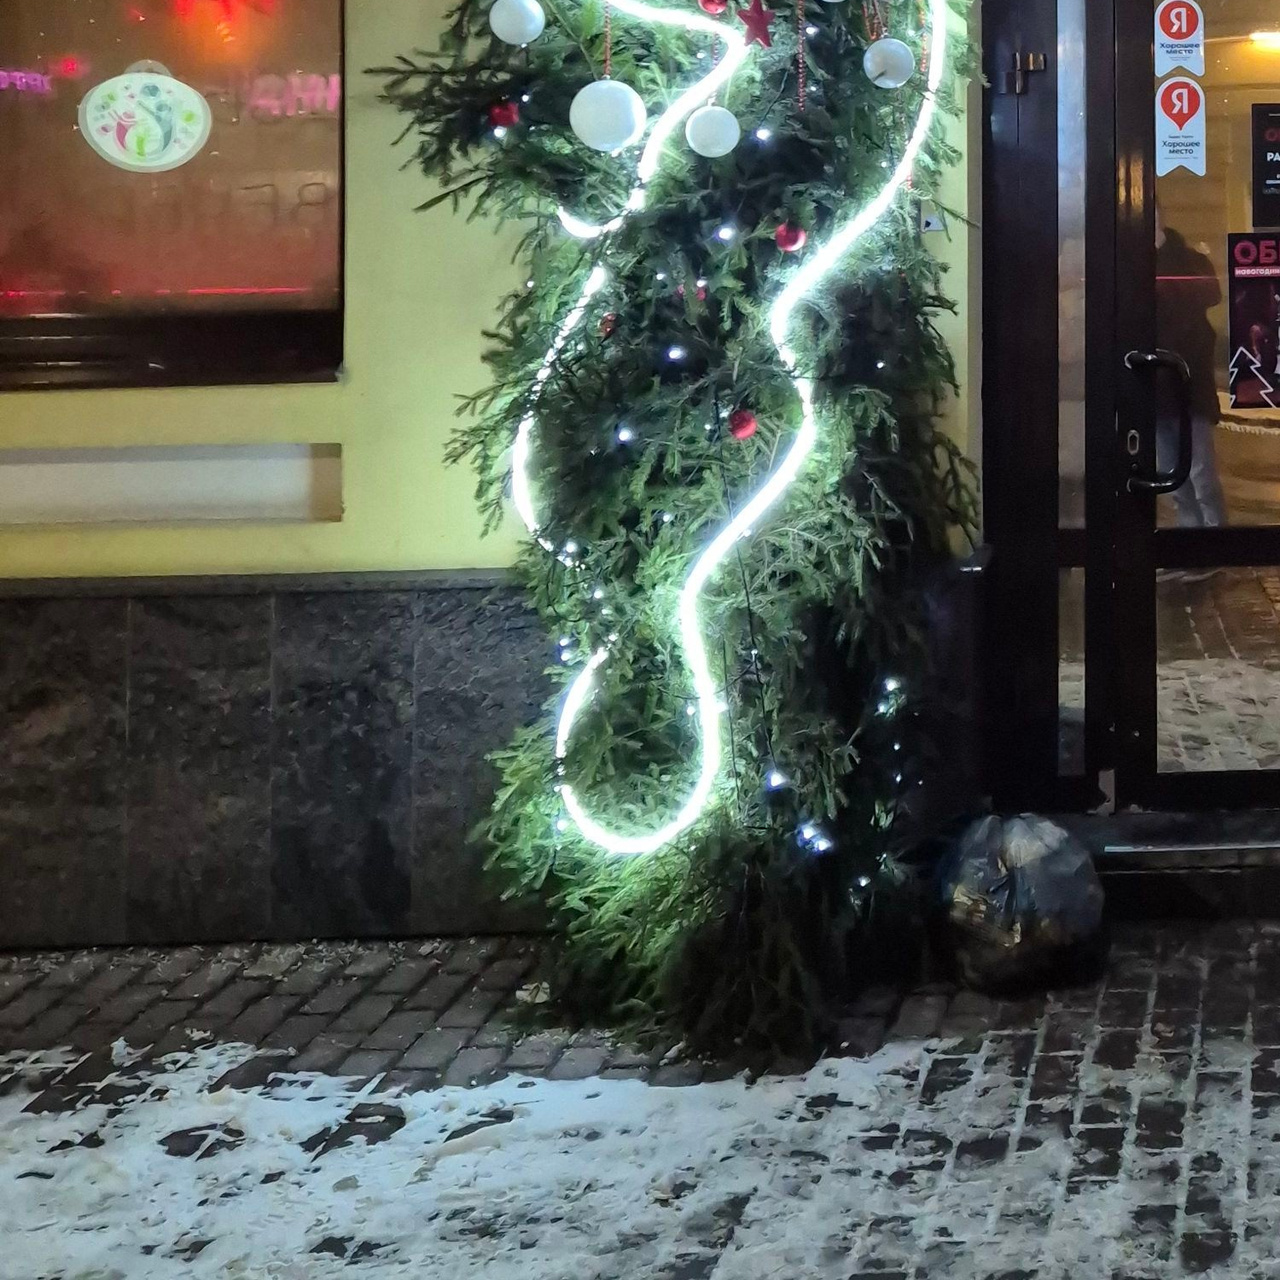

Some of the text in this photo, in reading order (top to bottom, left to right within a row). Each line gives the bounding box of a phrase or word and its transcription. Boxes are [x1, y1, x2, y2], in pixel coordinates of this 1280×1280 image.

[1170, 7, 1187, 33] Я
[1171, 88, 1189, 114] Я
[1162, 140, 1200, 148] Хорошее
